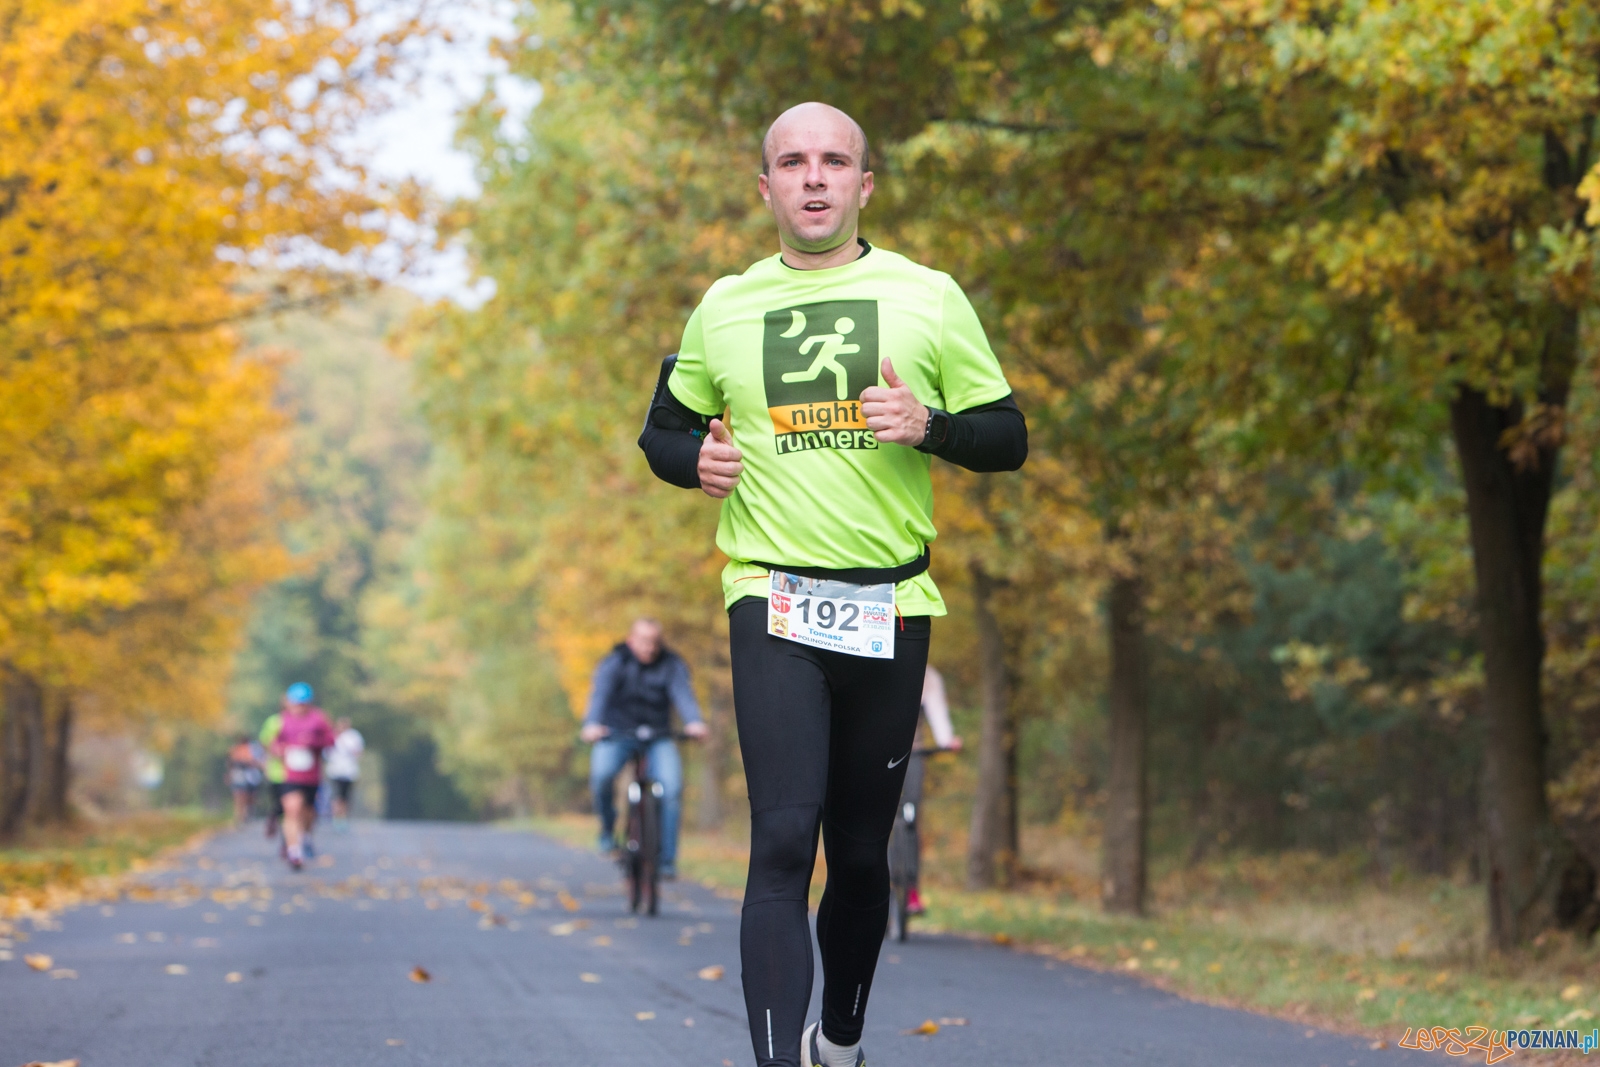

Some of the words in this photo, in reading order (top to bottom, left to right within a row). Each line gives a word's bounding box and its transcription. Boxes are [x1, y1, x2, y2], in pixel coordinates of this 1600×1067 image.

[791, 402, 859, 429] night
[776, 430, 878, 454] runners
[796, 598, 860, 632] 192
[797, 634, 832, 647] POLINOVA
[833, 643, 861, 653] POLSKA
[808, 627, 844, 642] Tomasz
